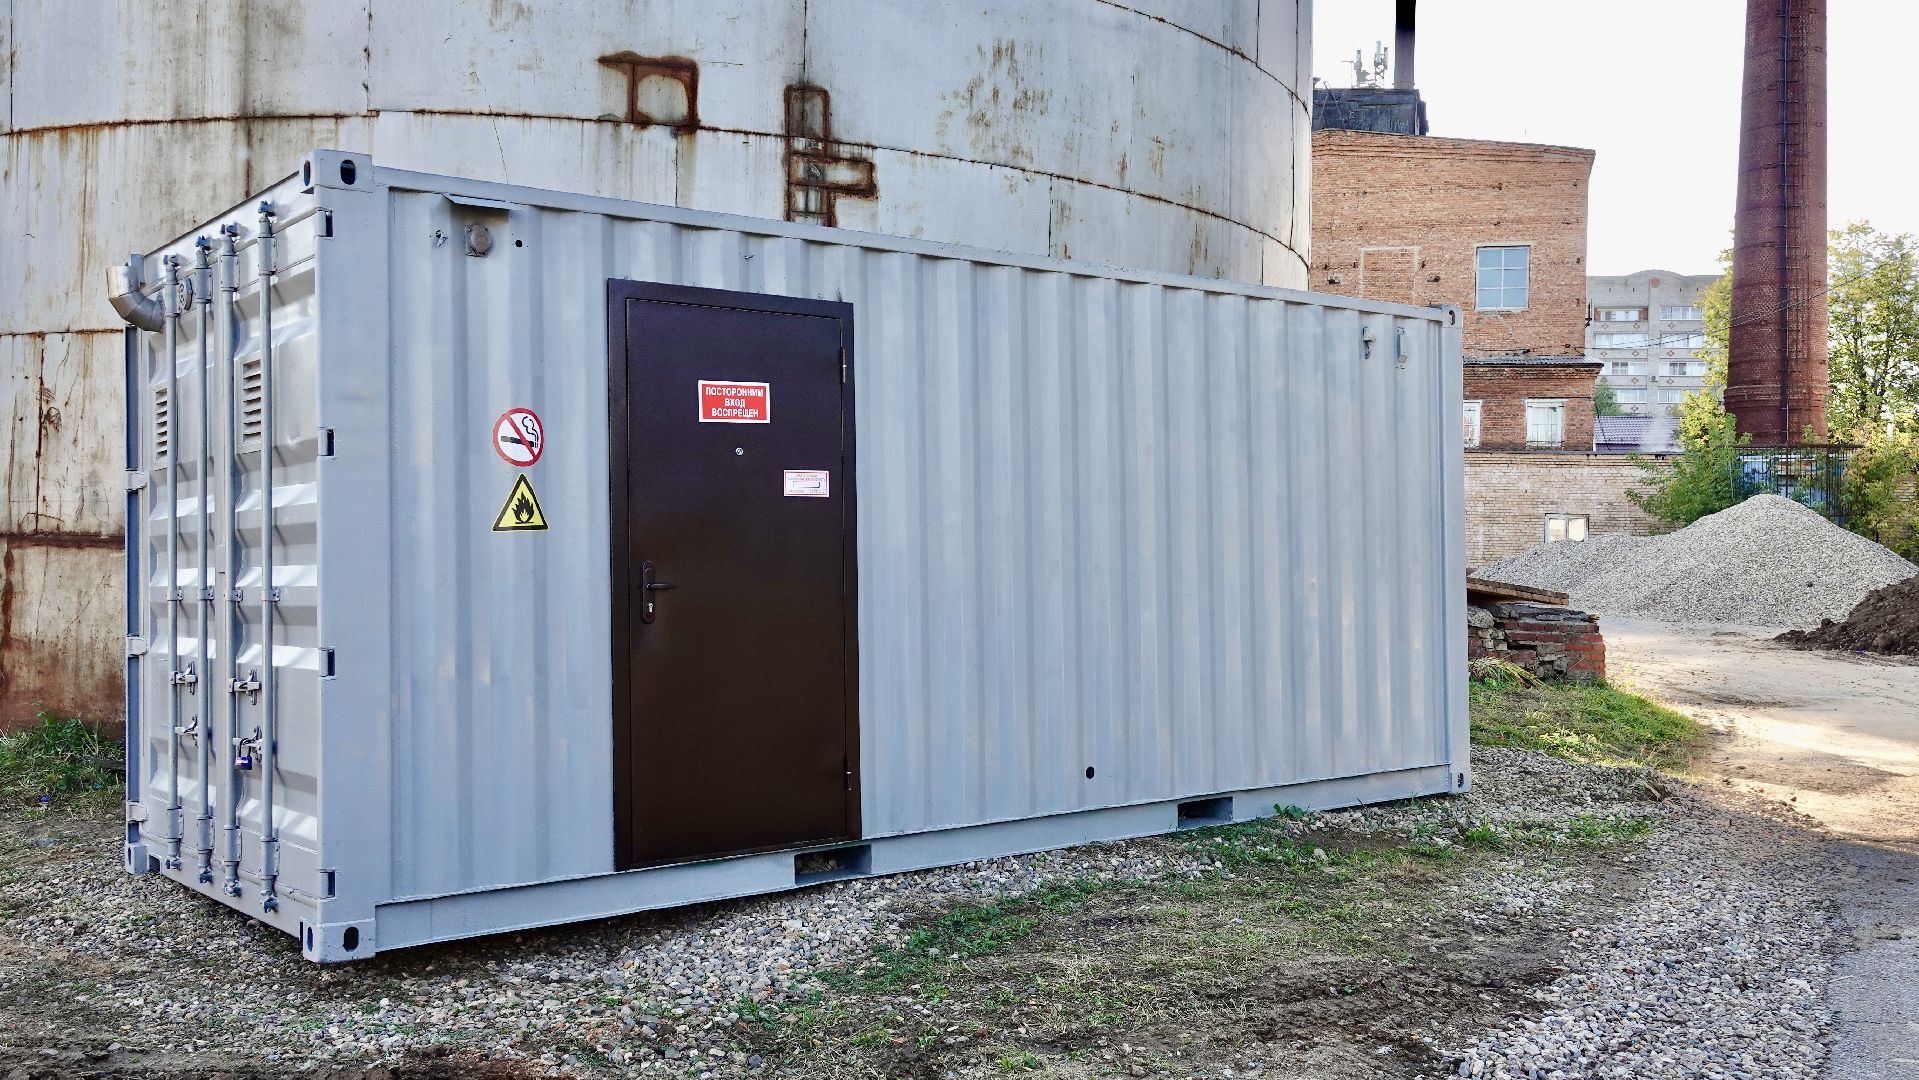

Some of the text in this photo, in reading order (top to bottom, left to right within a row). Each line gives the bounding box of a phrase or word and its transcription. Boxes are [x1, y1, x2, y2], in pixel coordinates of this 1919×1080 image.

[705, 387, 764, 397] ПОСТОРОННИМ
[724, 398, 746, 408] ВХОД
[711, 408, 759, 418] ВОСПРЕЩЕН
